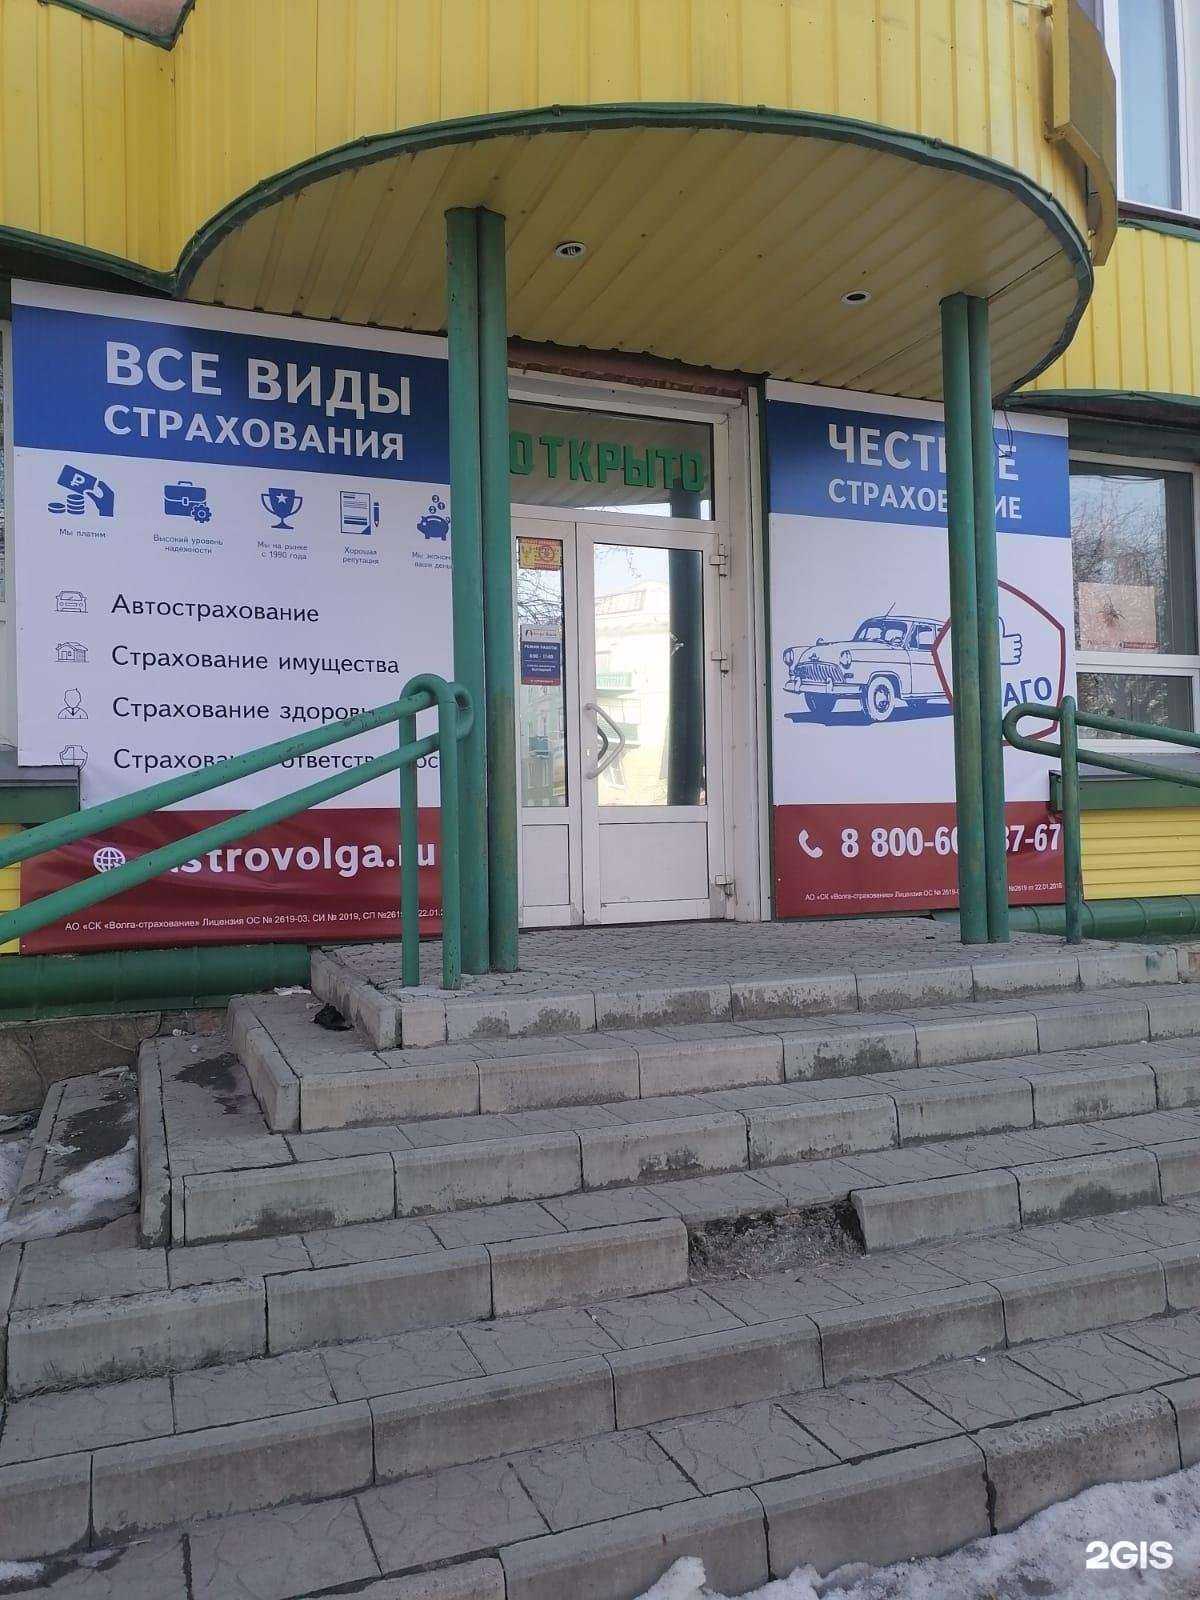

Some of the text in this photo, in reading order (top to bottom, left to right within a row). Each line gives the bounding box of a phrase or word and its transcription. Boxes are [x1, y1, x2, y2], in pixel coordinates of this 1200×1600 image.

[105, 341, 410, 419] ВСЕ ВИДЫ
[104, 404, 404, 460] СТРАХОВАНИЯ
[508, 431, 705, 492] ОТКРЫТО
[829, 424, 1019, 480] ЧЕСТЕ
[828, 478, 1022, 519] СТРАХОВИЕ
[59, 527, 107, 539] Мы платим
[153, 534, 223, 547] Высокий уровень
[257, 540, 271, 549] Мы
[284, 544, 308, 552] рынке
[269, 550, 287, 559] 1990
[289, 552, 307, 560] года
[342, 556, 379, 565] репутация
[344, 546, 377, 556] Хорошая
[111, 594, 320, 622] Автострахование
[111, 645, 399, 675] Страхование имущества
[1003, 677, 1052, 707] АГО
[113, 697, 375, 724] Страхование здоров
[114, 749, 234, 773] Страхов
[841, 823, 1061, 858] 8 800-67-67
[169, 837, 436, 878] strovolga.u
[941, 888, 960, 896] 2619-
[65, 922, 80, 931] АО
[83, 921, 101, 931] «СК
[104, 919, 200, 931] «Волга-страхование»
[202, 917, 244, 928] Лицензия
[247, 916, 261, 925] ОС
[263, 915, 272, 924] №
[312, 913, 325, 923] СИ
[328, 912, 337, 922] №
